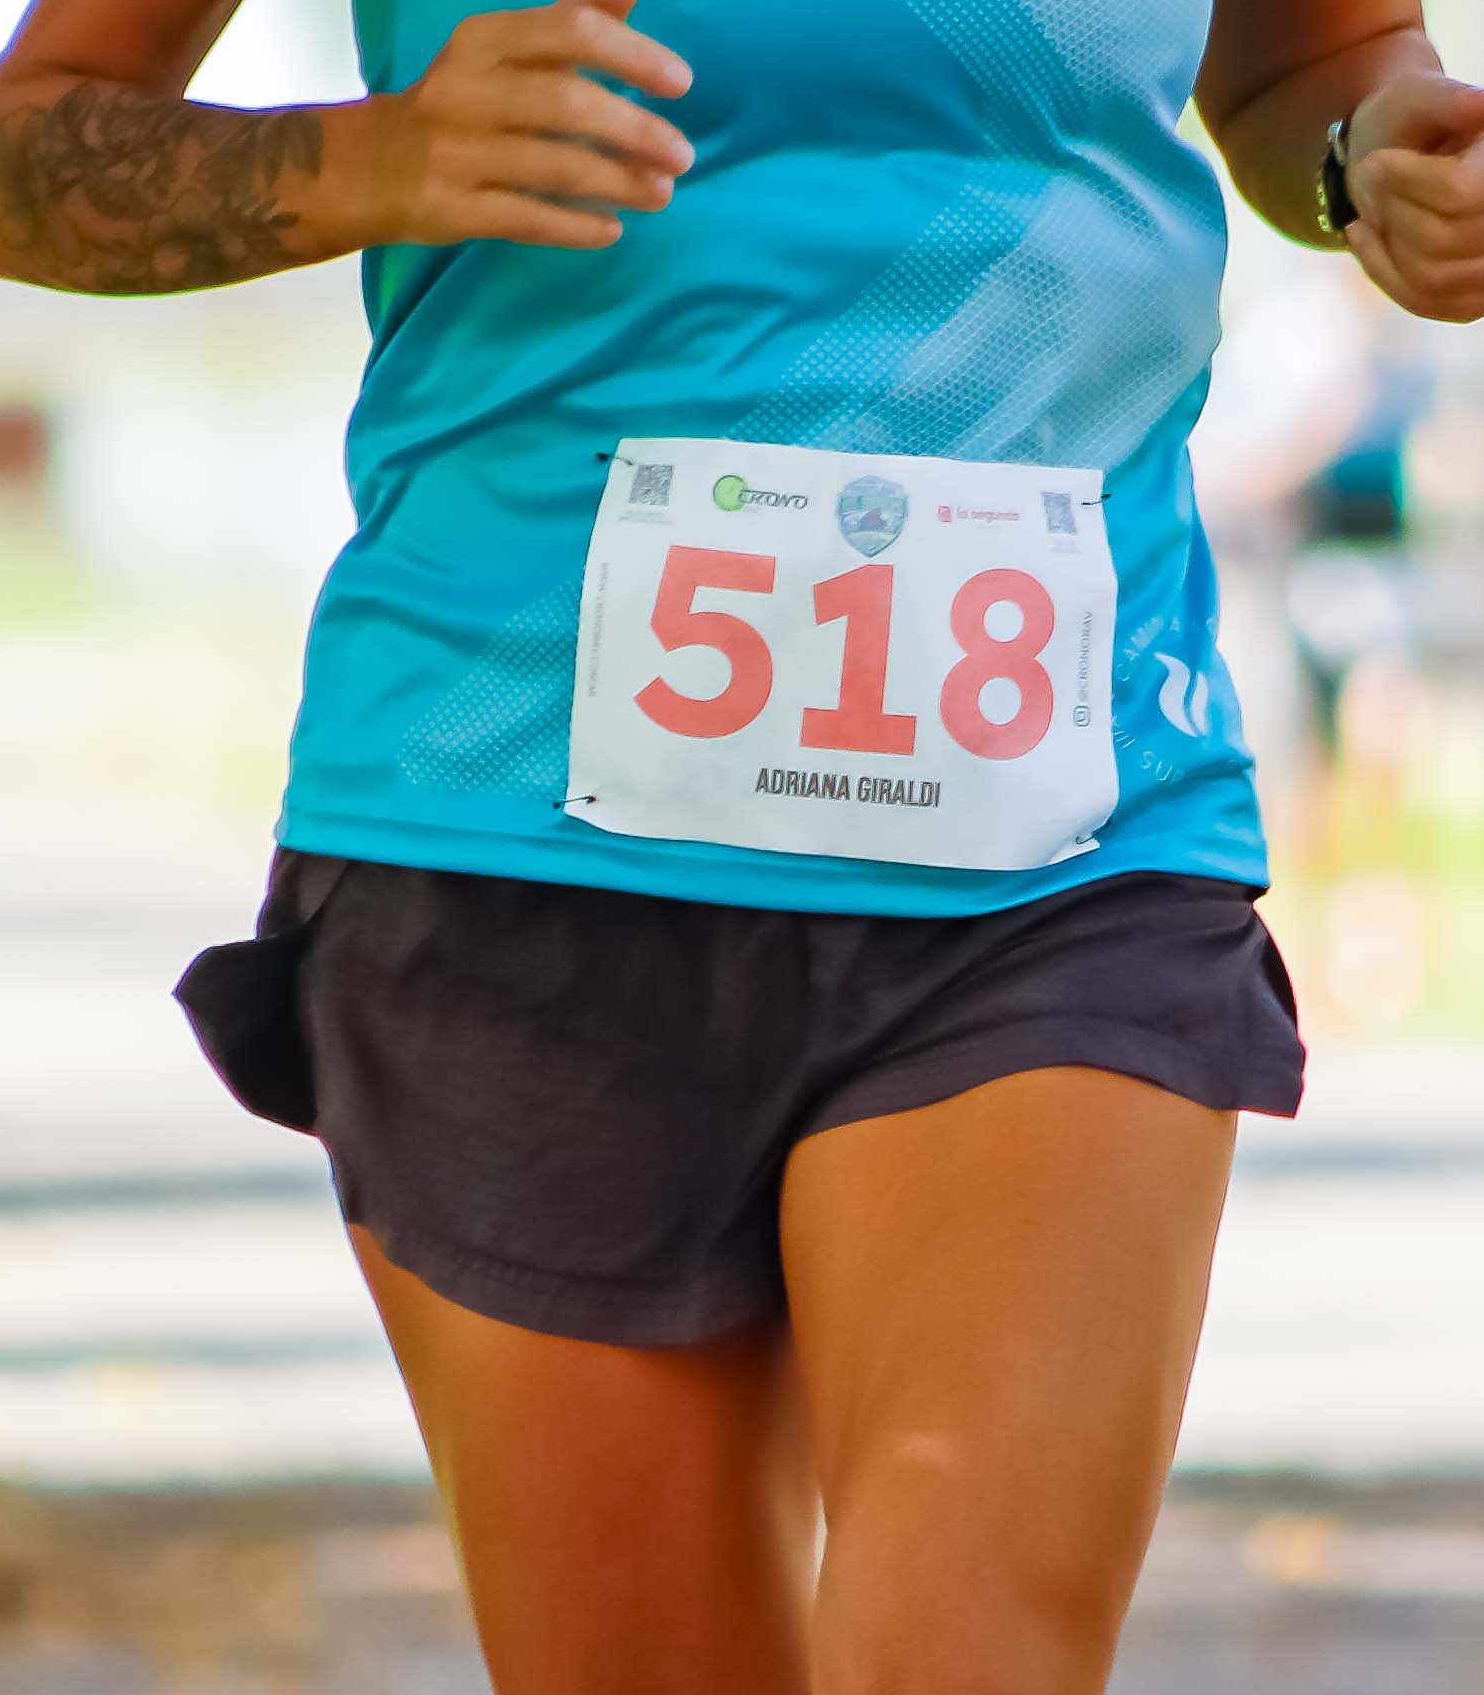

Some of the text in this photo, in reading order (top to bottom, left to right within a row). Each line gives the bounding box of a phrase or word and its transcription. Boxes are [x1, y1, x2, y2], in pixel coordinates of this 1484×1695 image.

[633, 544, 1055, 761] 518
[755, 767, 942, 808] ADRIANA GIRALDI
